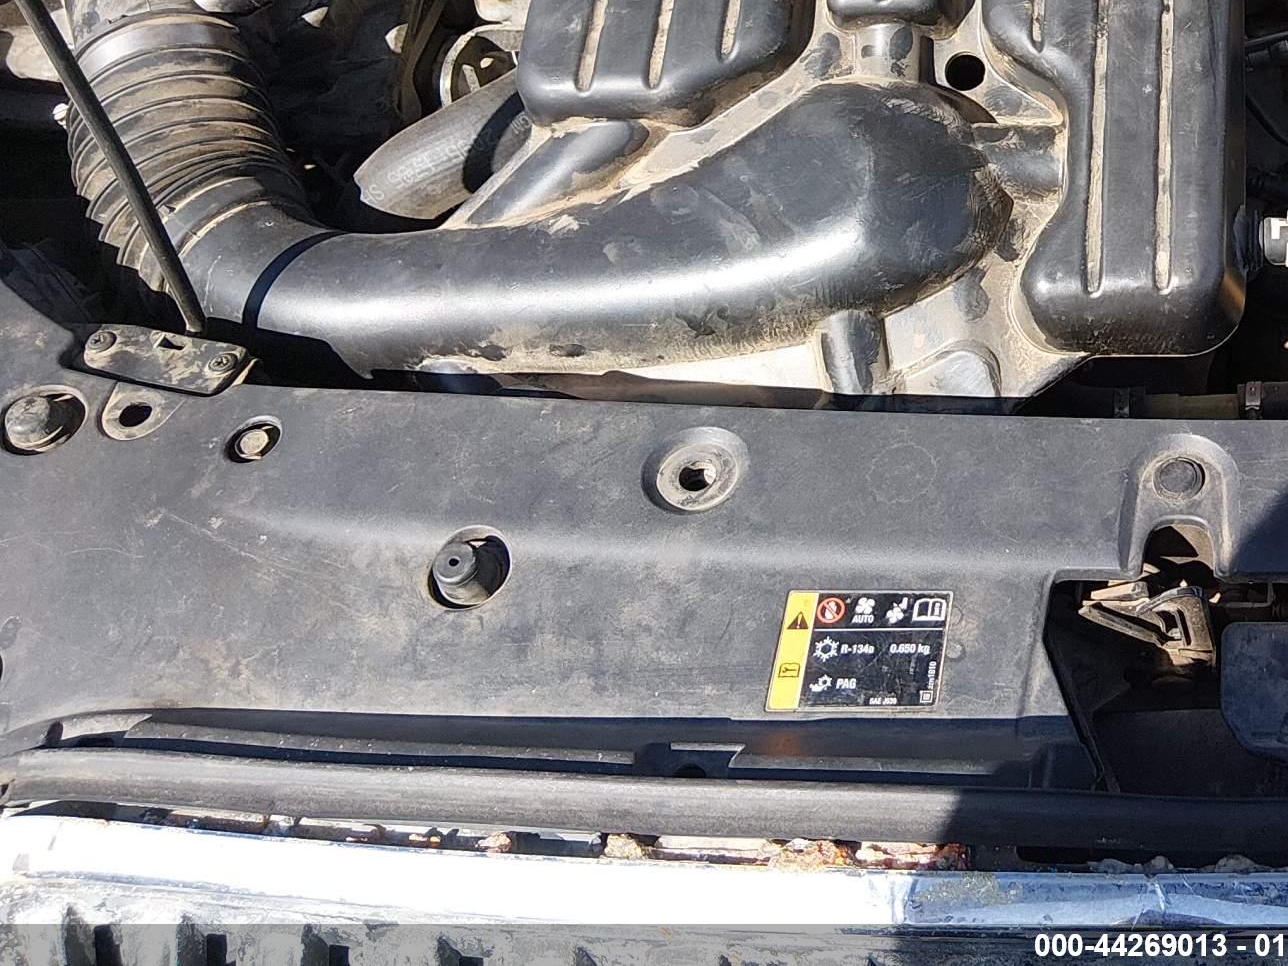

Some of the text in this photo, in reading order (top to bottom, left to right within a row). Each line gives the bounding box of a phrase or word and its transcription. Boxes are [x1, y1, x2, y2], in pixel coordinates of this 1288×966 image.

[852, 614, 874, 623] AUTO
[840, 643, 931, 655] R-134a 0.650 kg
[835, 678, 857, 689] PAG
